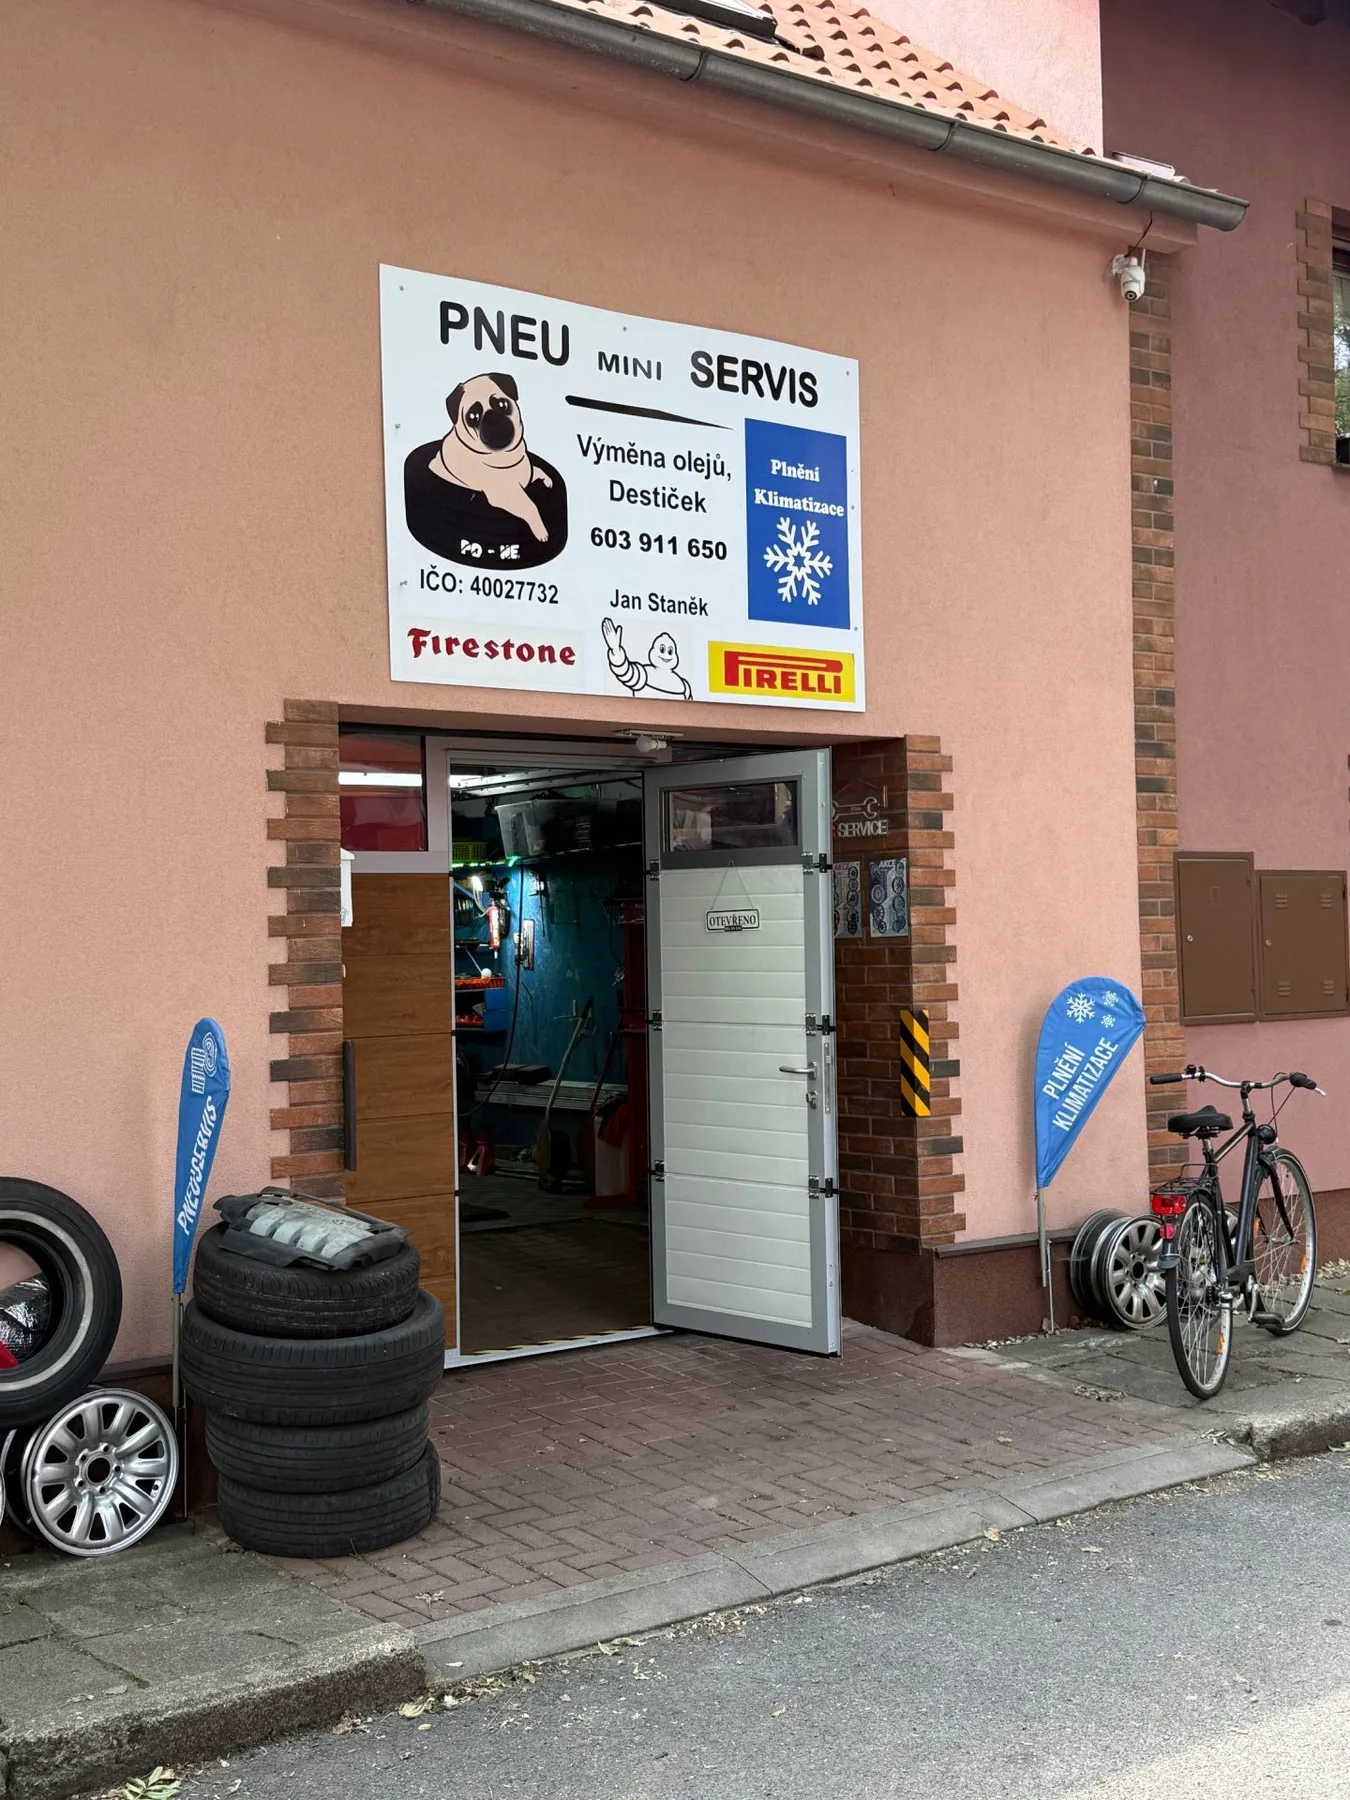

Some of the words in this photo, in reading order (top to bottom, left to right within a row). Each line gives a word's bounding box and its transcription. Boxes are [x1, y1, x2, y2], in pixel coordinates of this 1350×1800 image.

[439, 300, 570, 367] PNEU
[597, 351, 663, 381] MINI
[690, 350, 820, 409] SERVIS
[576, 433, 666, 471] Výměna
[673, 451, 732, 481] olejů,
[770, 458, 821, 483] Plnění
[608, 479, 707, 515] Destiček
[754, 488, 845, 518] Klimatizace
[590, 527, 632, 551] 603
[639, 531, 679, 556] 911
[687, 536, 728, 561] 650
[419, 564, 464, 595] IČO:
[470, 573, 559, 605] 40027732
[609, 588, 642, 611] Jan
[648, 592, 709, 618] Staněk
[407, 627, 577, 667] Firestone
[724, 650, 844, 695] PIRELLI
[837, 820, 889, 838] SERVICE
[708, 913, 757, 927] OTEVŘENO
[1041, 1040, 1086, 1100] PLNĚNÍ
[1051, 1036, 1119, 1132] KLIMATIZACE
[176, 1095, 217, 1237] PNEUSERVIS
